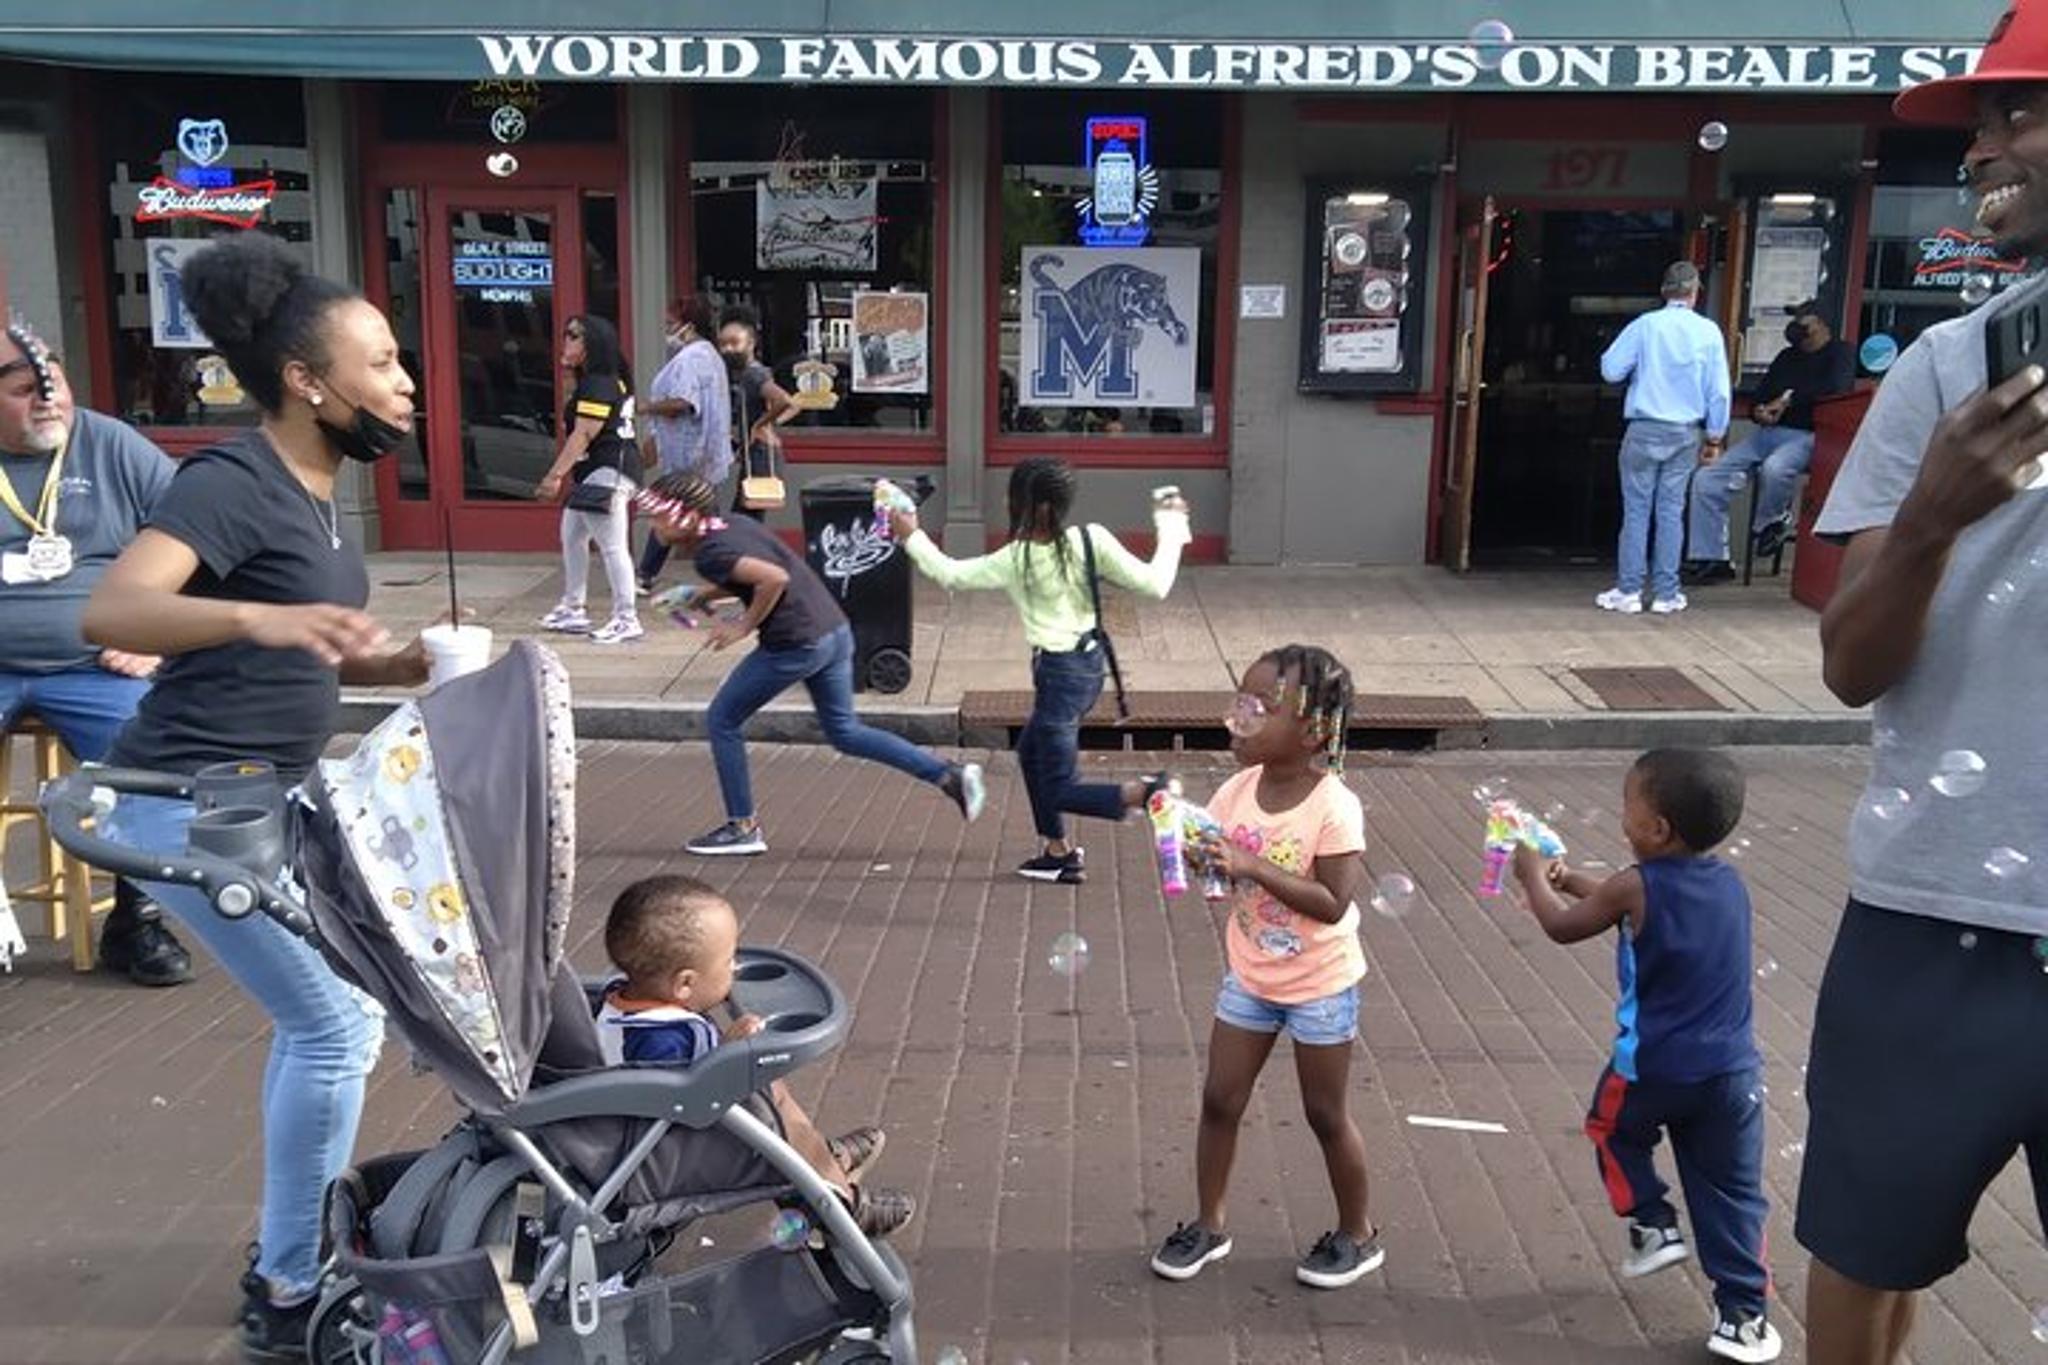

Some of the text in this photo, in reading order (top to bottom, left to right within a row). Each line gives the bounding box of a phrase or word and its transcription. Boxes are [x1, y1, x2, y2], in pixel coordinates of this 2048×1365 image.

[477, 35, 760, 78] WORLD
[781, 39, 1101, 83] FAMOUS
[1119, 43, 1479, 86] ALFRED'S
[1501, 46, 1614, 86] ON
[1634, 46, 1877, 87] BEALE
[1540, 147, 1629, 189] 197
[138, 187, 271, 214] Budweiser
[454, 262, 553, 279] BUD LIGHT
[1033, 287, 1138, 398] M
